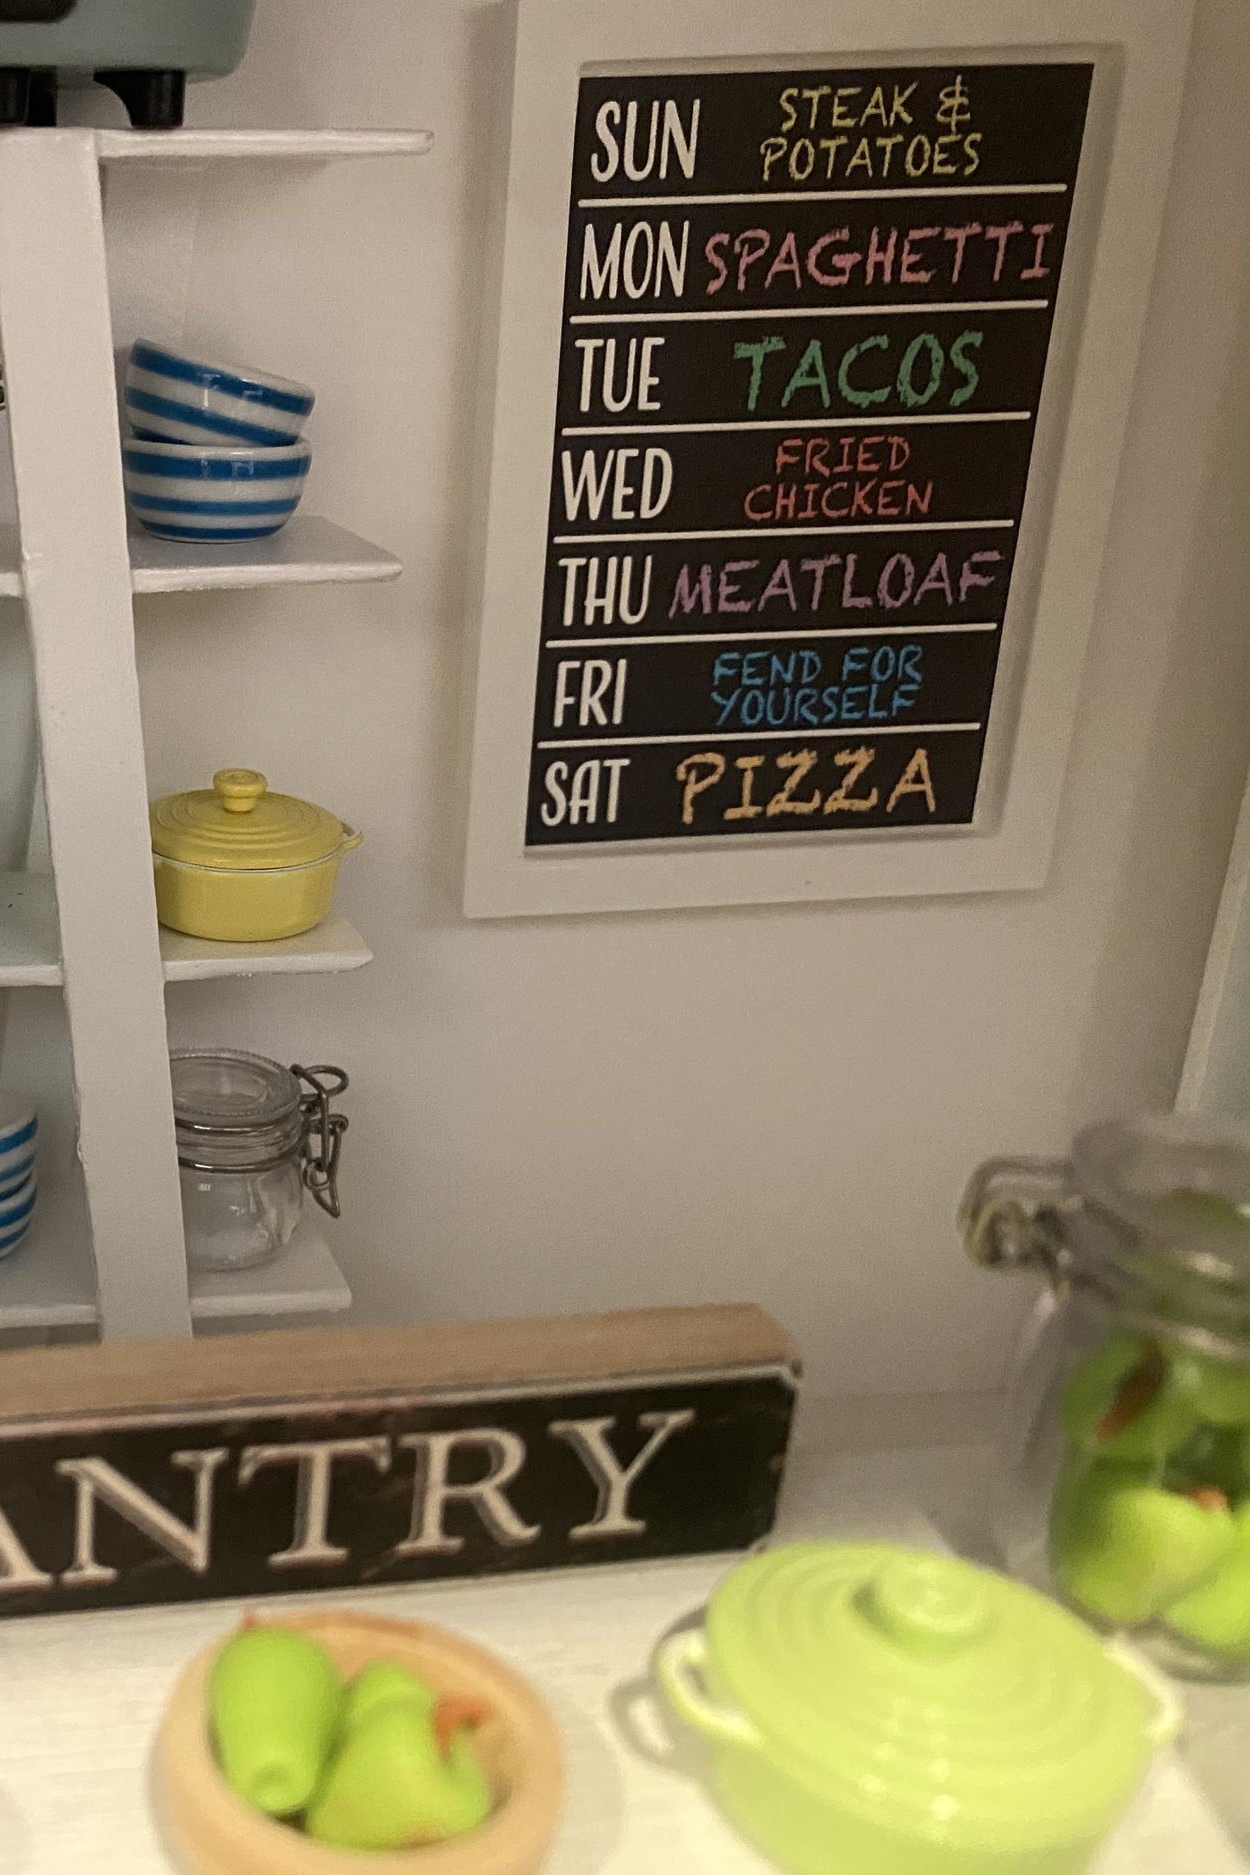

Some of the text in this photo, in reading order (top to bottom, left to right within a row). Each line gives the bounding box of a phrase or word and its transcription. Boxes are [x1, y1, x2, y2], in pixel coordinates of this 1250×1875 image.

[779, 75, 971, 134] STEAK &
[590, 99, 700, 182] SUN
[760, 132, 982, 181] POTATOES
[580, 220, 1054, 300] MON SPAGHETTI
[575, 331, 984, 412] TUE TACOS
[561, 448, 673, 521] WED
[775, 436, 909, 476] FRIED
[744, 480, 933, 522] CHICKEN
[559, 550, 1004, 626] THU MEATLOAF
[553, 659, 626, 728] FRI
[712, 644, 923, 687] FEND FOR
[711, 682, 922, 726] YOURSELF
[541, 746, 937, 826] SAT PIZZA
